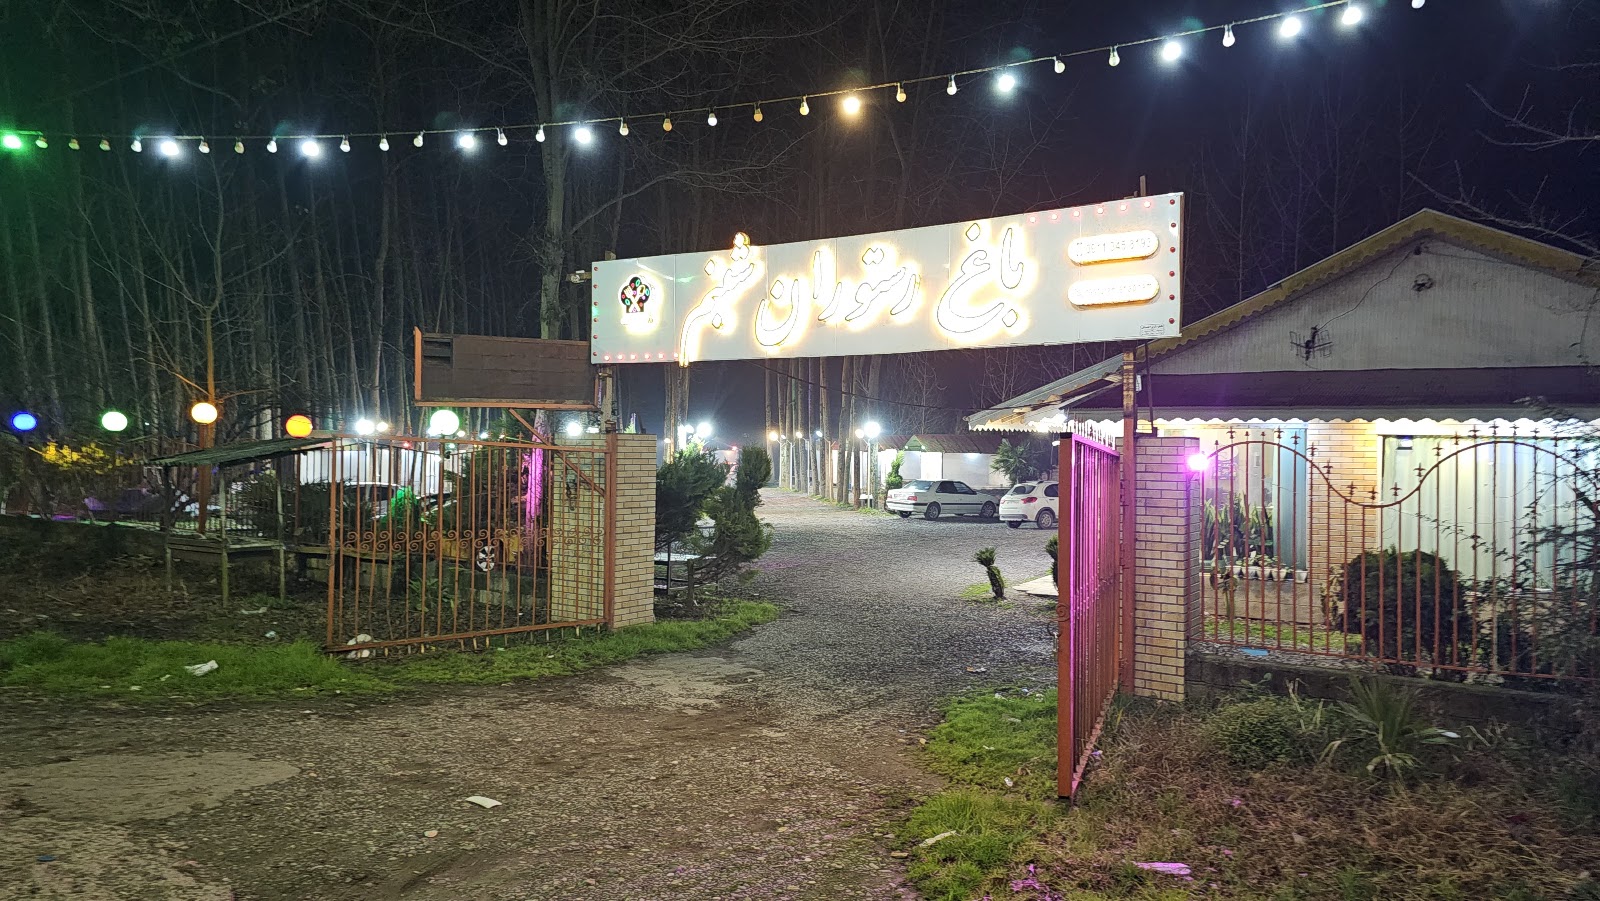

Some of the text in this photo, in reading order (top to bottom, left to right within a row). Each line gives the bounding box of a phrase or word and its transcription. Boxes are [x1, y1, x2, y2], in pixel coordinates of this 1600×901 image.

[679, 222, 1024, 367] باغ رستوران شبنم
